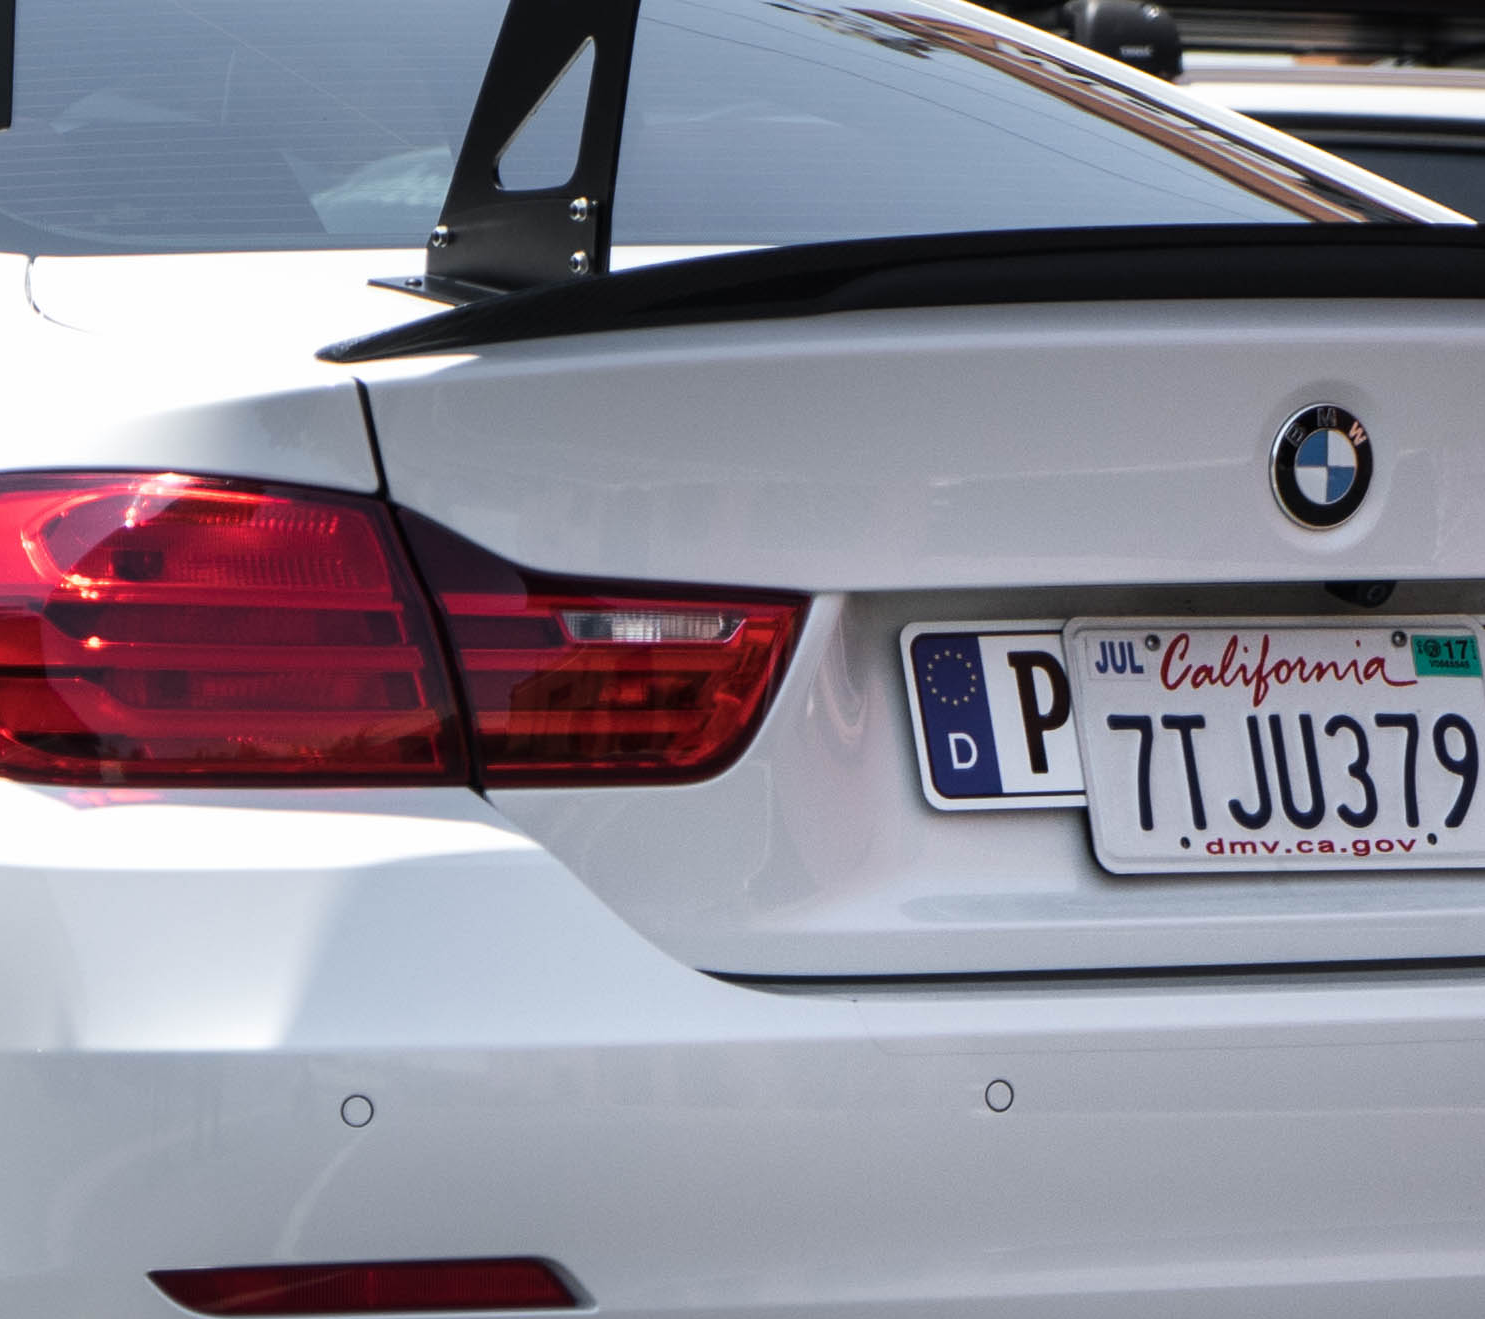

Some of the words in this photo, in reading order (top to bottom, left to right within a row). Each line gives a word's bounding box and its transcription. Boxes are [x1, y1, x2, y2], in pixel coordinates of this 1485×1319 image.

[1286, 407, 1367, 447] BMW
[1095, 640, 1144, 674] JUL
[1443, 640, 1468, 659] 17
[1160, 632, 1418, 708] California
[948, 732, 978, 769] D
[1107, 712, 1479, 831] 7TJU379
[1205, 836, 1417, 857] dmv.ca.gov
